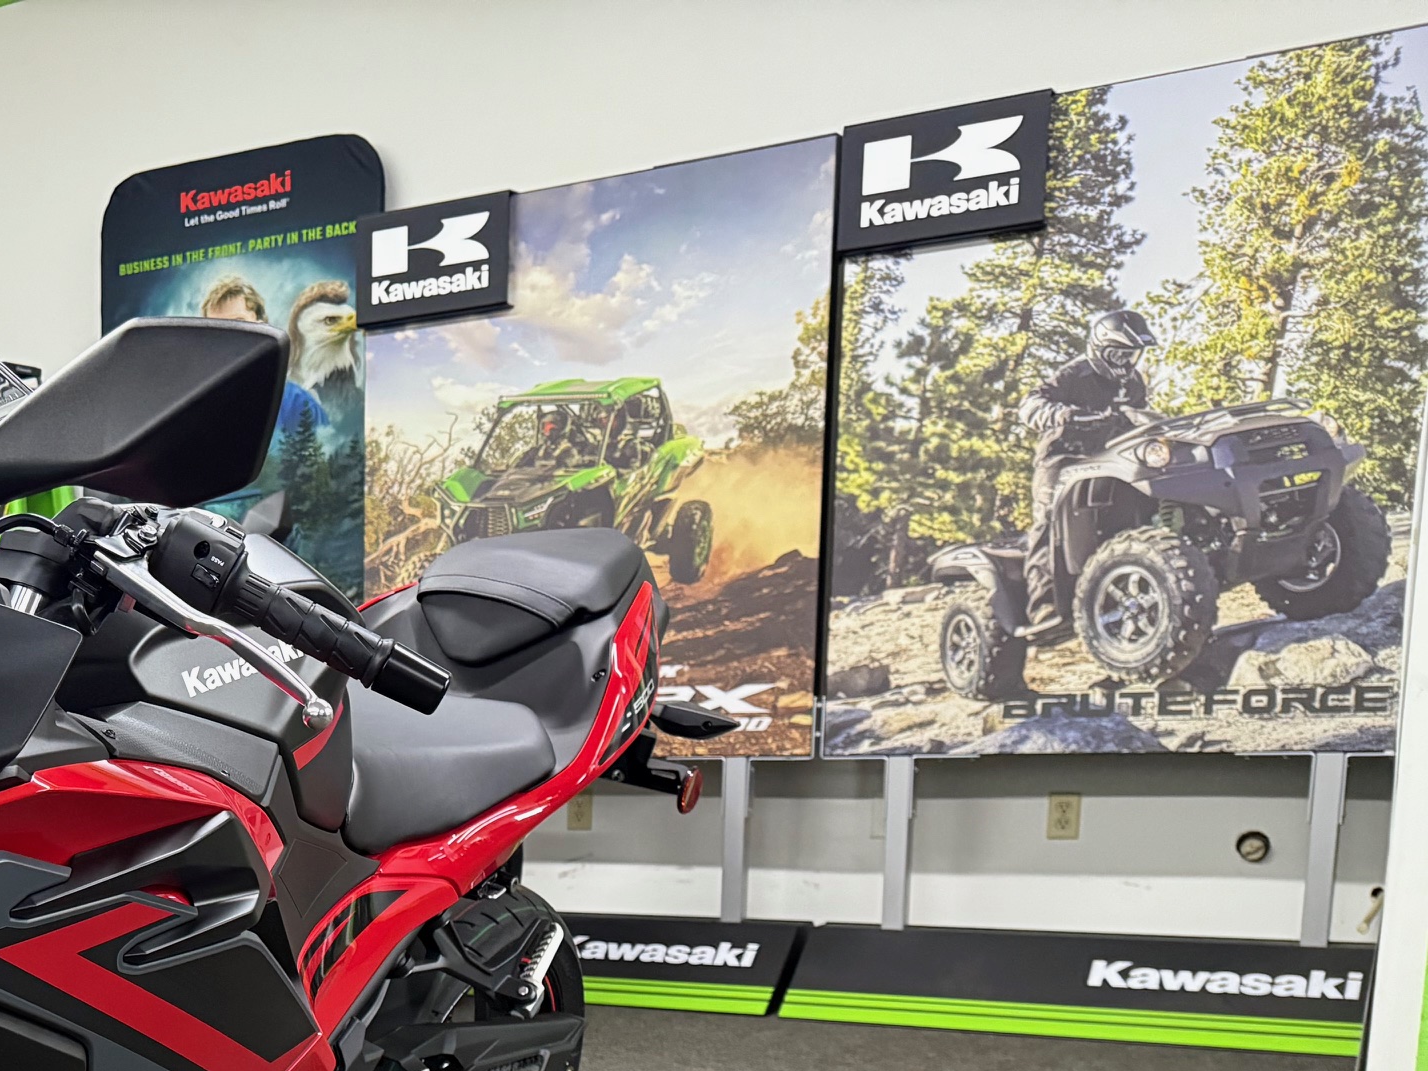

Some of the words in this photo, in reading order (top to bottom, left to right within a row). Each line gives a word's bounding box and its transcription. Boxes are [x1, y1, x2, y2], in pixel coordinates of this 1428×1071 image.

[180, 170, 291, 213] Kawasaki
[859, 177, 1020, 228] Kawasaki
[184, 215, 199, 227] Let
[201, 211, 215, 225] the
[216, 207, 240, 221] Good
[241, 204, 267, 217] Times
[119, 255, 170, 276] BUSINESS
[172, 253, 183, 267] IN
[186, 249, 206, 265] THE
[248, 234, 285, 253] PARTY
[286, 230, 299, 246] IN
[302, 226, 323, 243] THE
[325, 220, 358, 239] BACK
[371, 264, 490, 306] Kawasaki
[633, 678, 655, 715] 500
[1086, 959, 1364, 1001] Kawasaki
